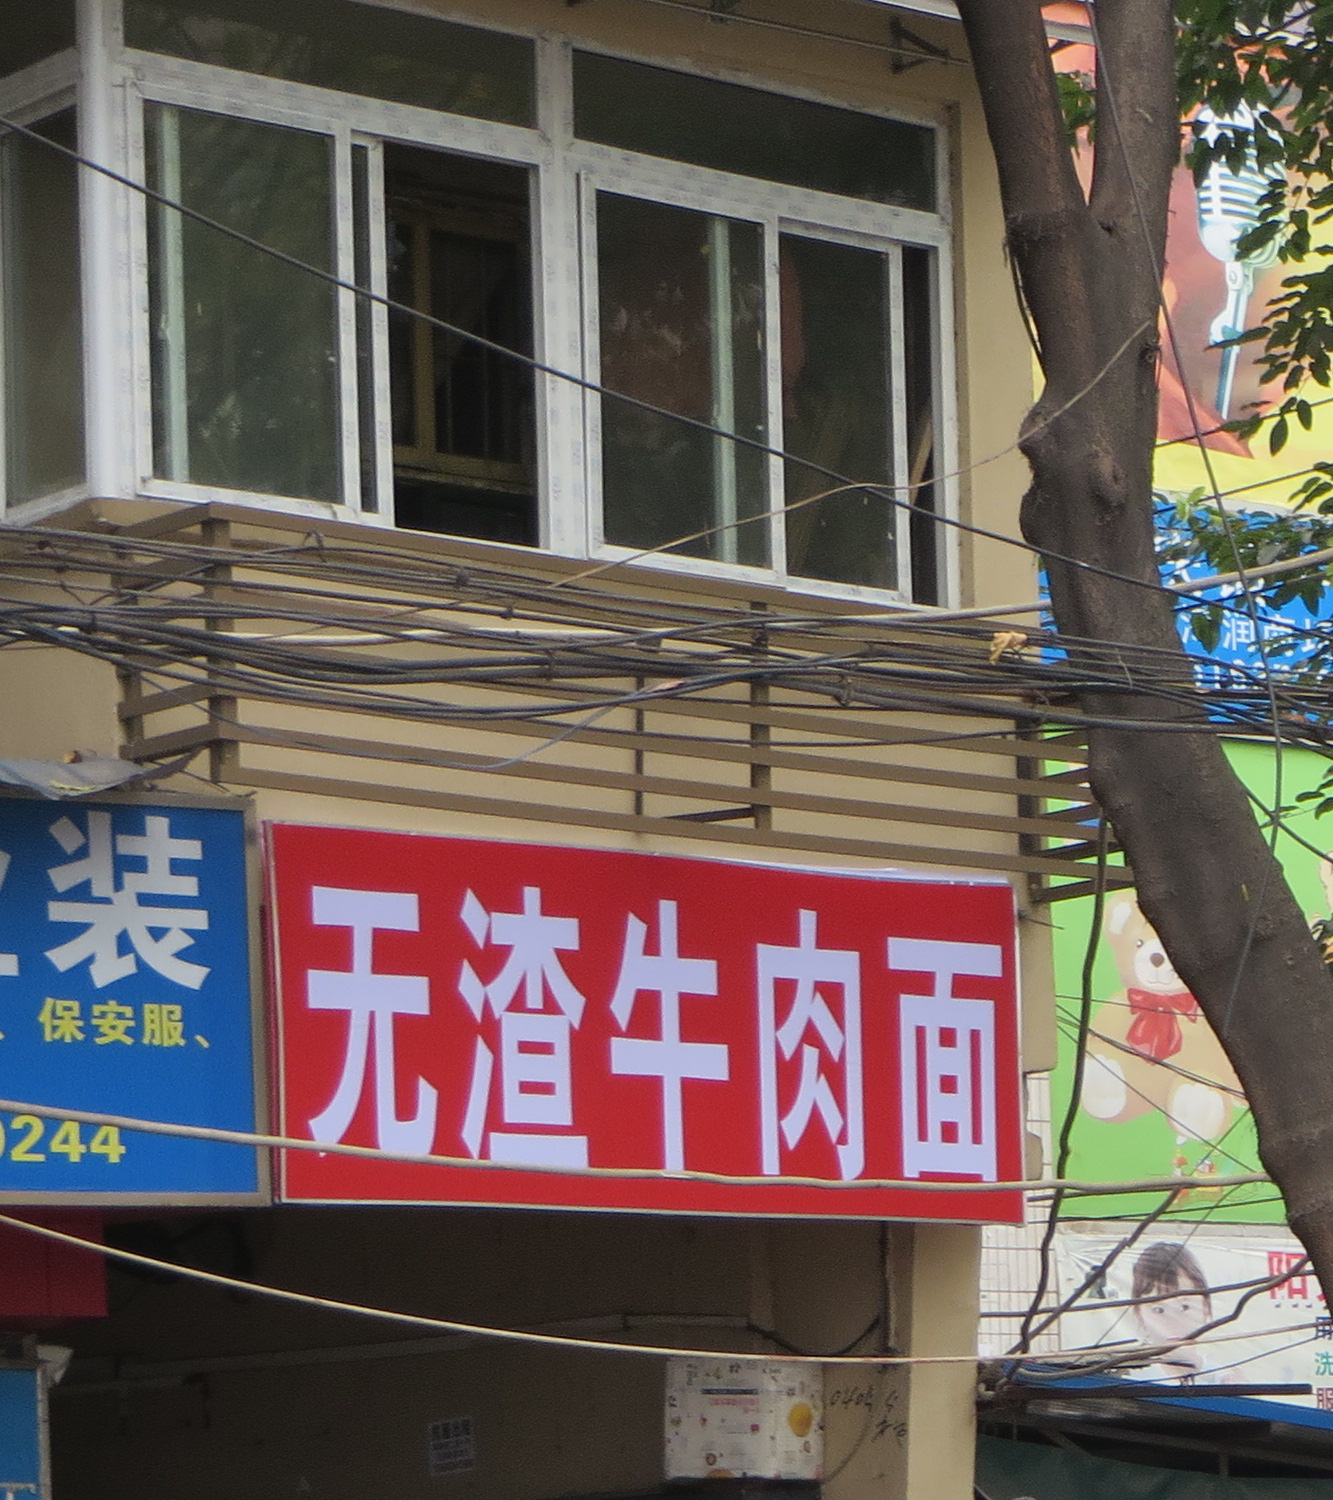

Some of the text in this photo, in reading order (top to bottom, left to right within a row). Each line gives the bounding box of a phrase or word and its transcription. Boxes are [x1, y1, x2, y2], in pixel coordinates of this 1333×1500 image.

[0, 811, 211, 990] 装
[306, 884, 1003, 1183] 无渣牛肉面
